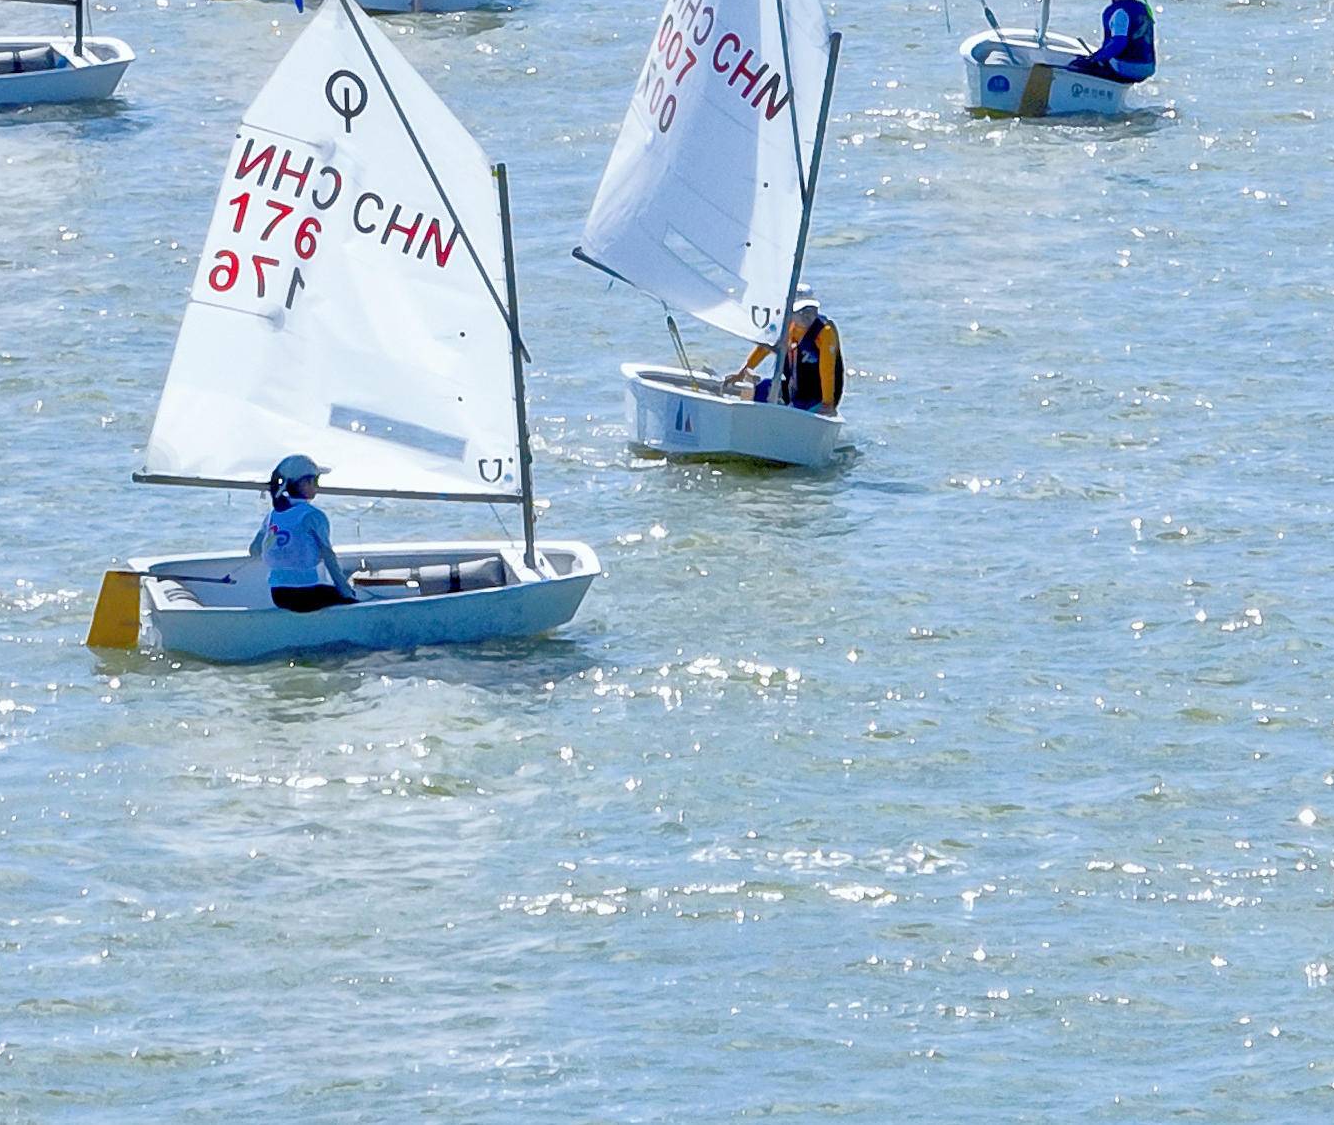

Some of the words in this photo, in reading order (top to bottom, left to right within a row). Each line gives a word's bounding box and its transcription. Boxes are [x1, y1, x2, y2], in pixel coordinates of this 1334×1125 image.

[658, 14, 697, 86] 007
[713, 32, 793, 121] CHN
[229, 192, 322, 259] 176
[353, 192, 459, 268] CHN
